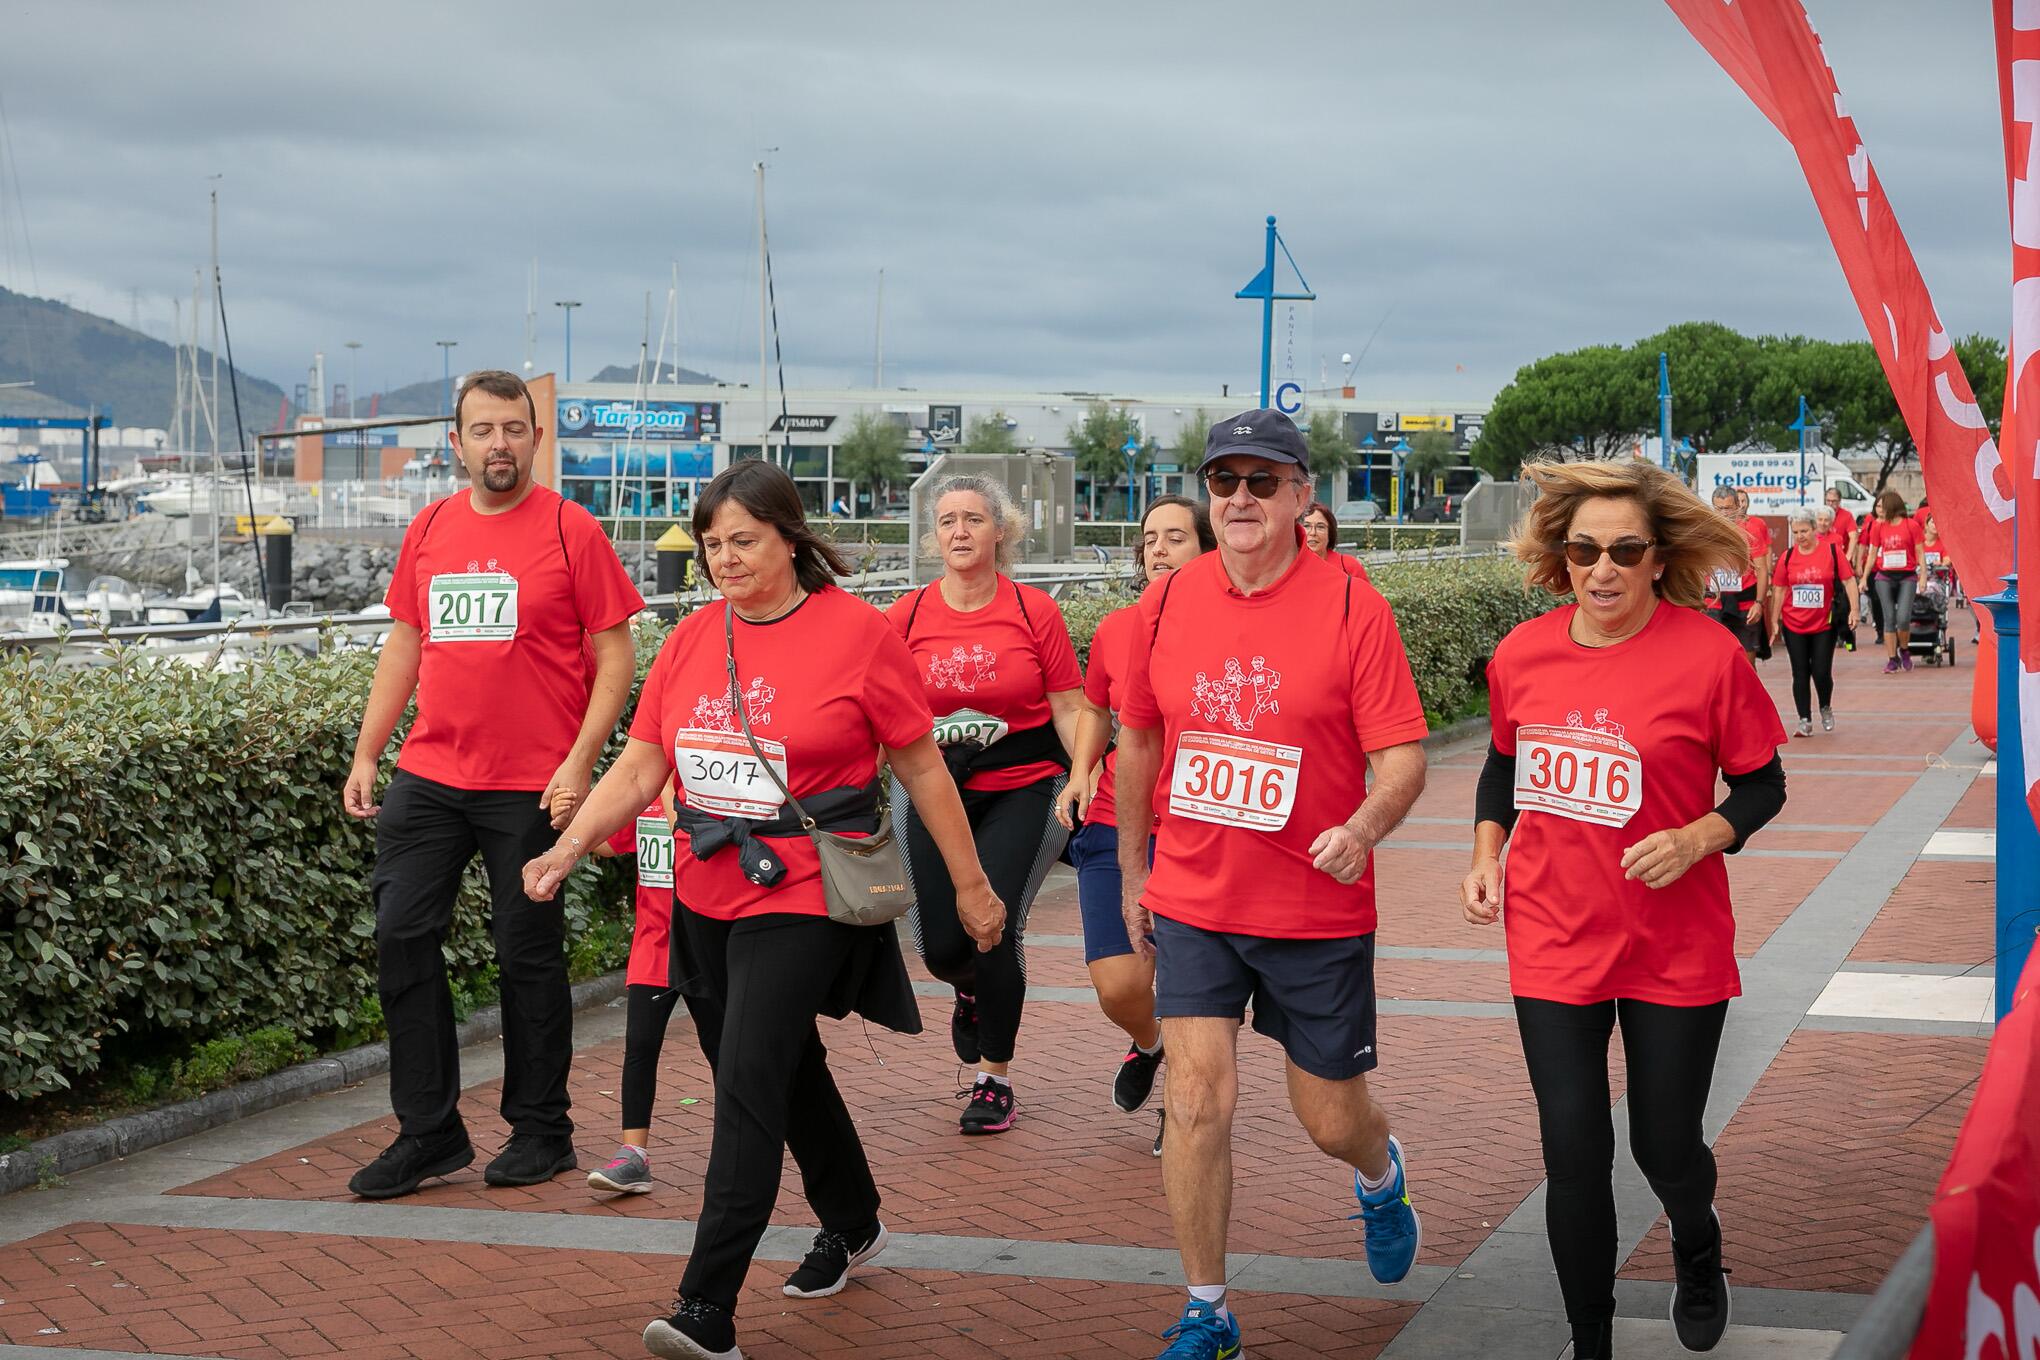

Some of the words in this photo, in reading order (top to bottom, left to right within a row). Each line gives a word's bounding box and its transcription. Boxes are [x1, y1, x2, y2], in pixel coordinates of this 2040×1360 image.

[1276, 382, 1302, 414] C
[1714, 473, 1811, 490] telefurgo
[1807, 462, 1818, 475] A
[1767, 496, 1815, 505] furgoneas
[439, 593, 509, 625] 2017
[1797, 590, 1821, 603] 1003
[933, 722, 999, 746] 2027
[689, 754, 760, 786] 3017
[1185, 754, 1285, 811] 3016
[1529, 746, 1630, 804] 3016
